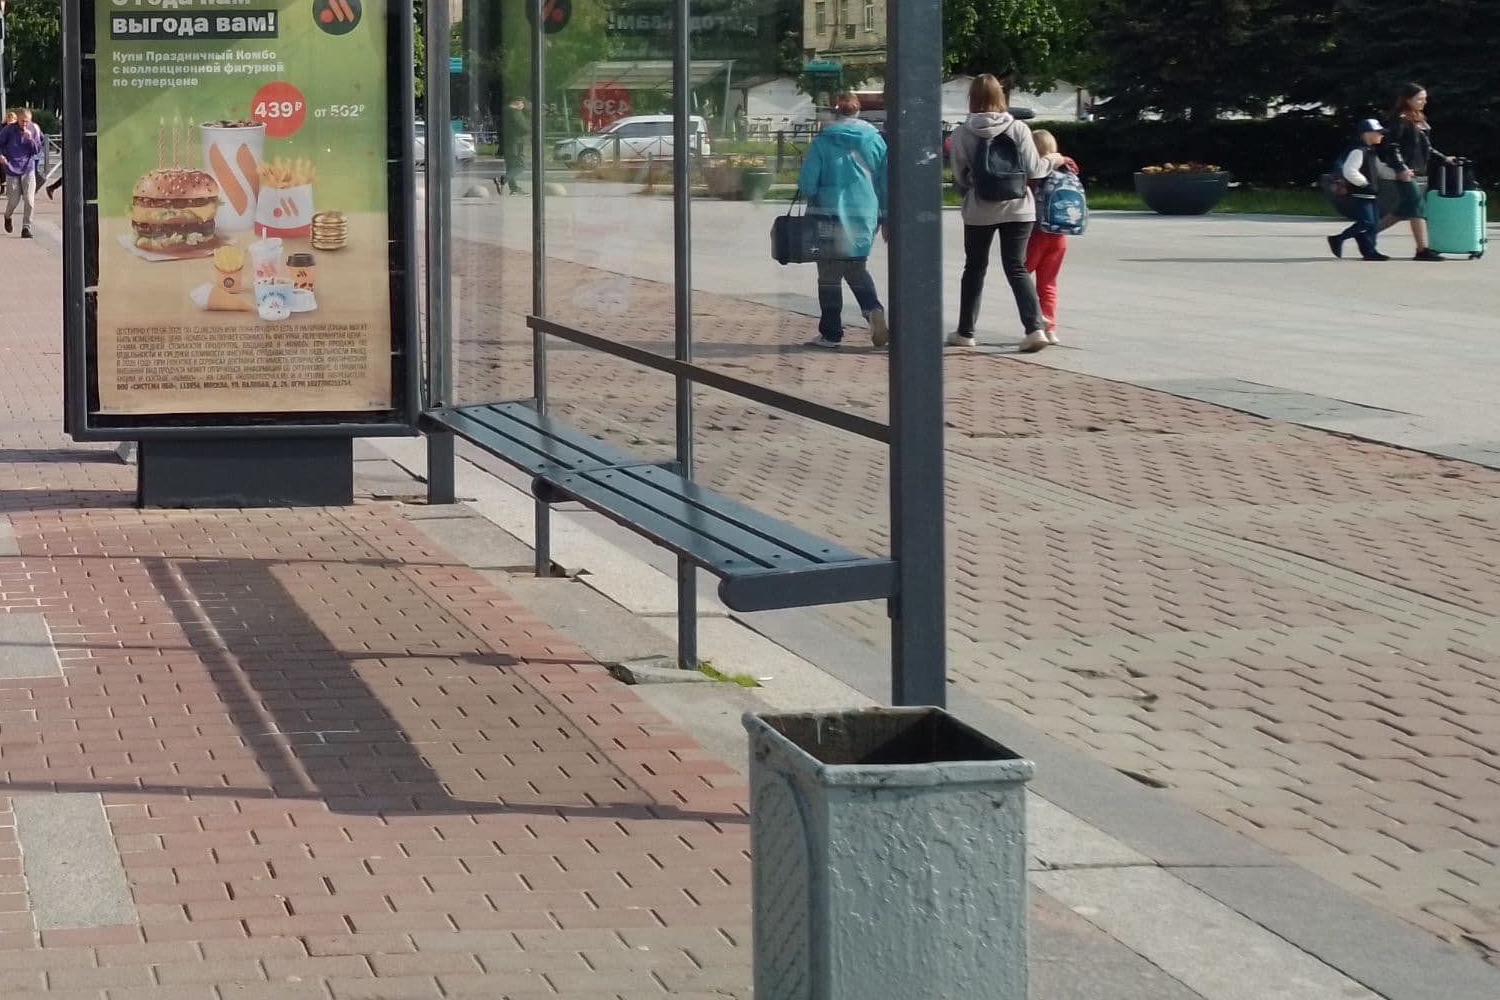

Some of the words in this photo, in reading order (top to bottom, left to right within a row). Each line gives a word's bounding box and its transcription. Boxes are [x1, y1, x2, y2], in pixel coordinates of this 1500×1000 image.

[112, 16, 209, 36] выгода
[216, 12, 275, 32] вам!
[112, 51, 143, 64] Купи
[146, 49, 233, 63] Праздничный
[236, 49, 277, 61] Комбо
[112, 66, 120, 74] с
[123, 63, 221, 75] коллекционной
[224, 62, 284, 75] фигуркой
[112, 78, 128, 87] по
[131, 77, 199, 89] суперцене
[314, 108, 326, 117] от
